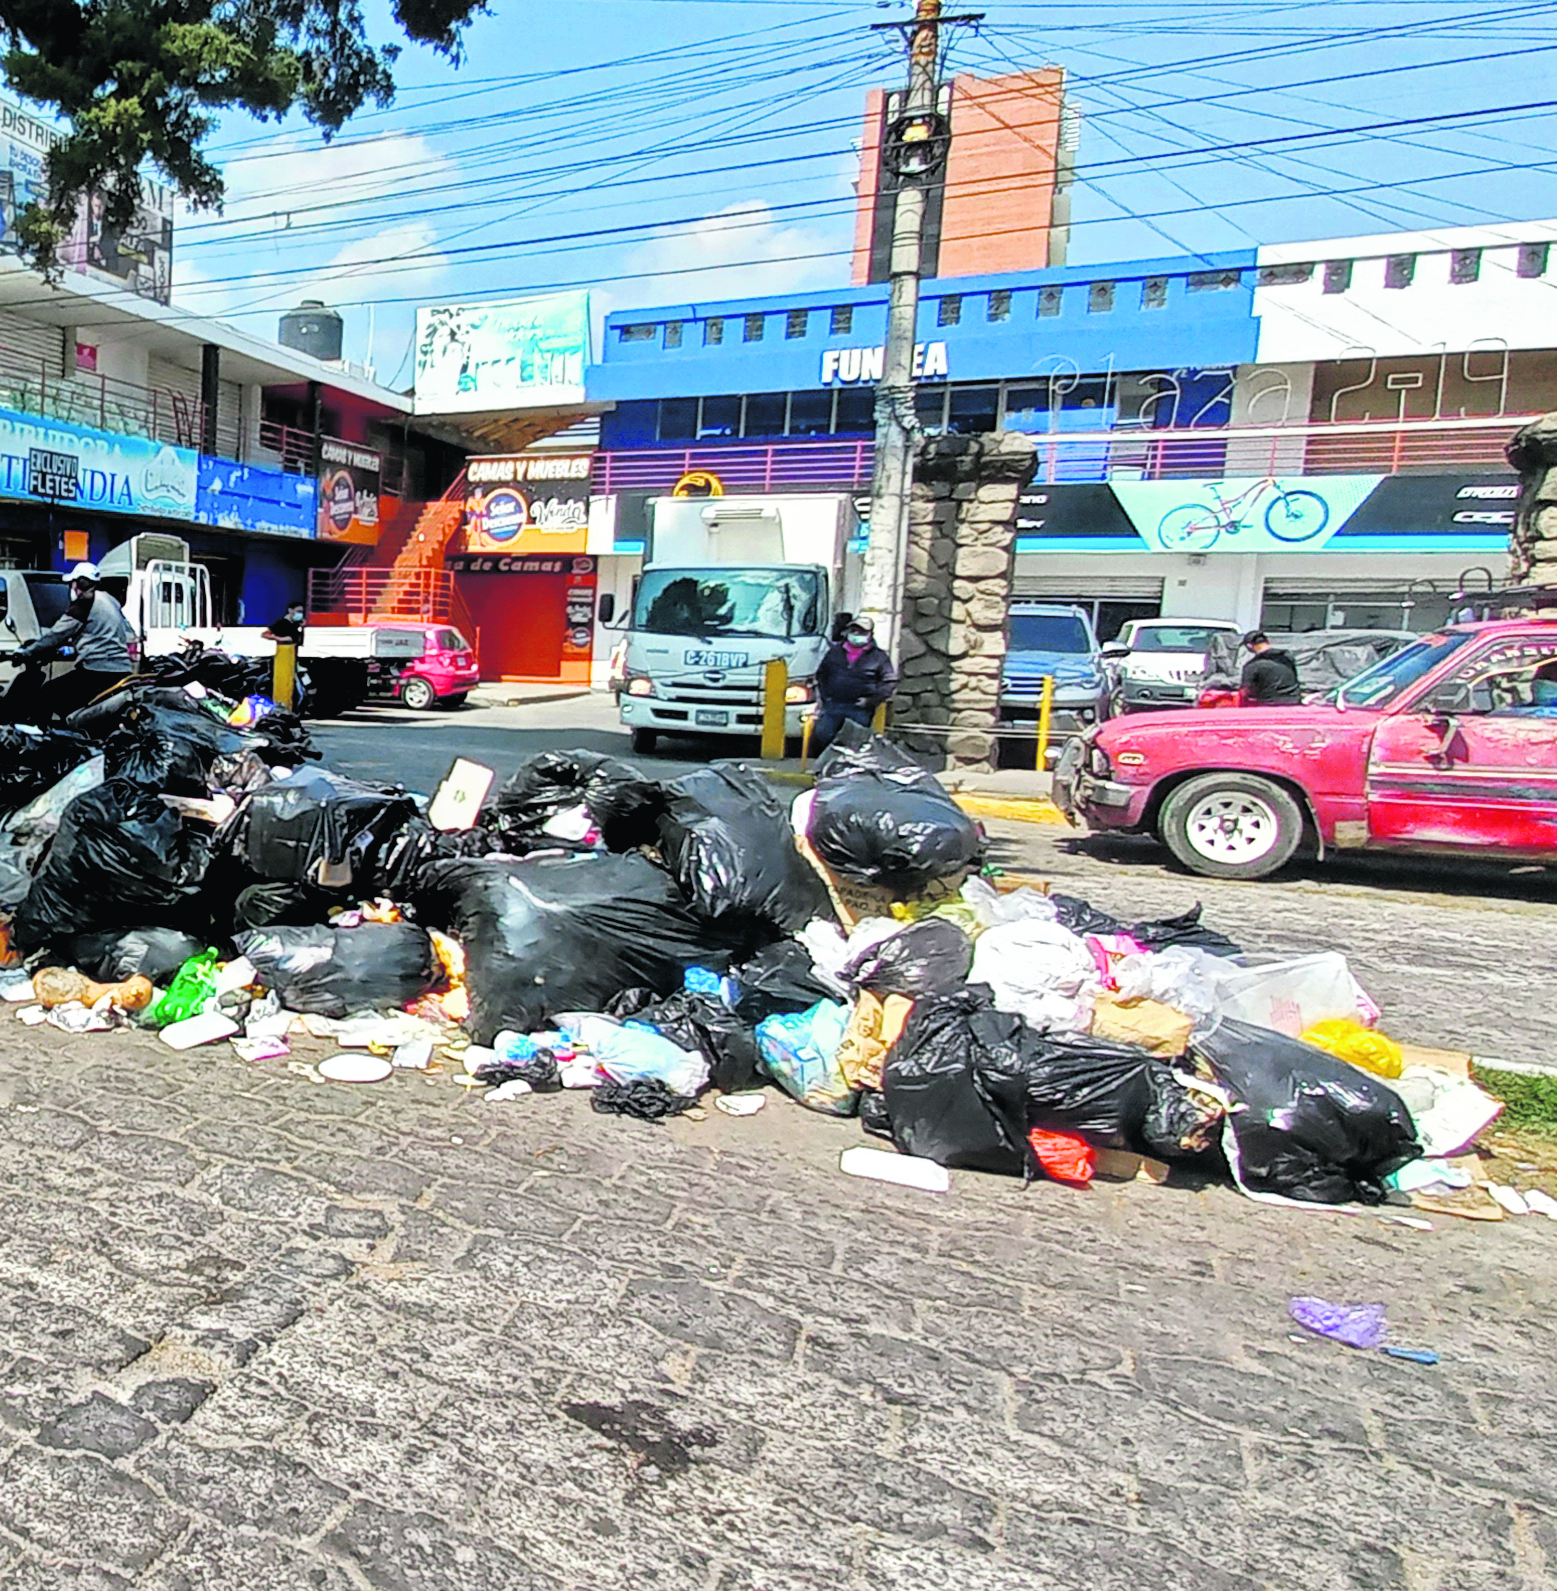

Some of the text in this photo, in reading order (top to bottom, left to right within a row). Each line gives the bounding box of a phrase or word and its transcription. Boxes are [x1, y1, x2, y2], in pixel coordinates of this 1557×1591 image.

[821, 342, 947, 384] FUNEA
[30, 449, 77, 477] EXCLUSIVO
[467, 458, 591, 482] CAMAS Y MUEBLES
[29, 472, 77, 498] FLETES
[470, 557, 493, 571] de
[497, 557, 563, 572] Camas
